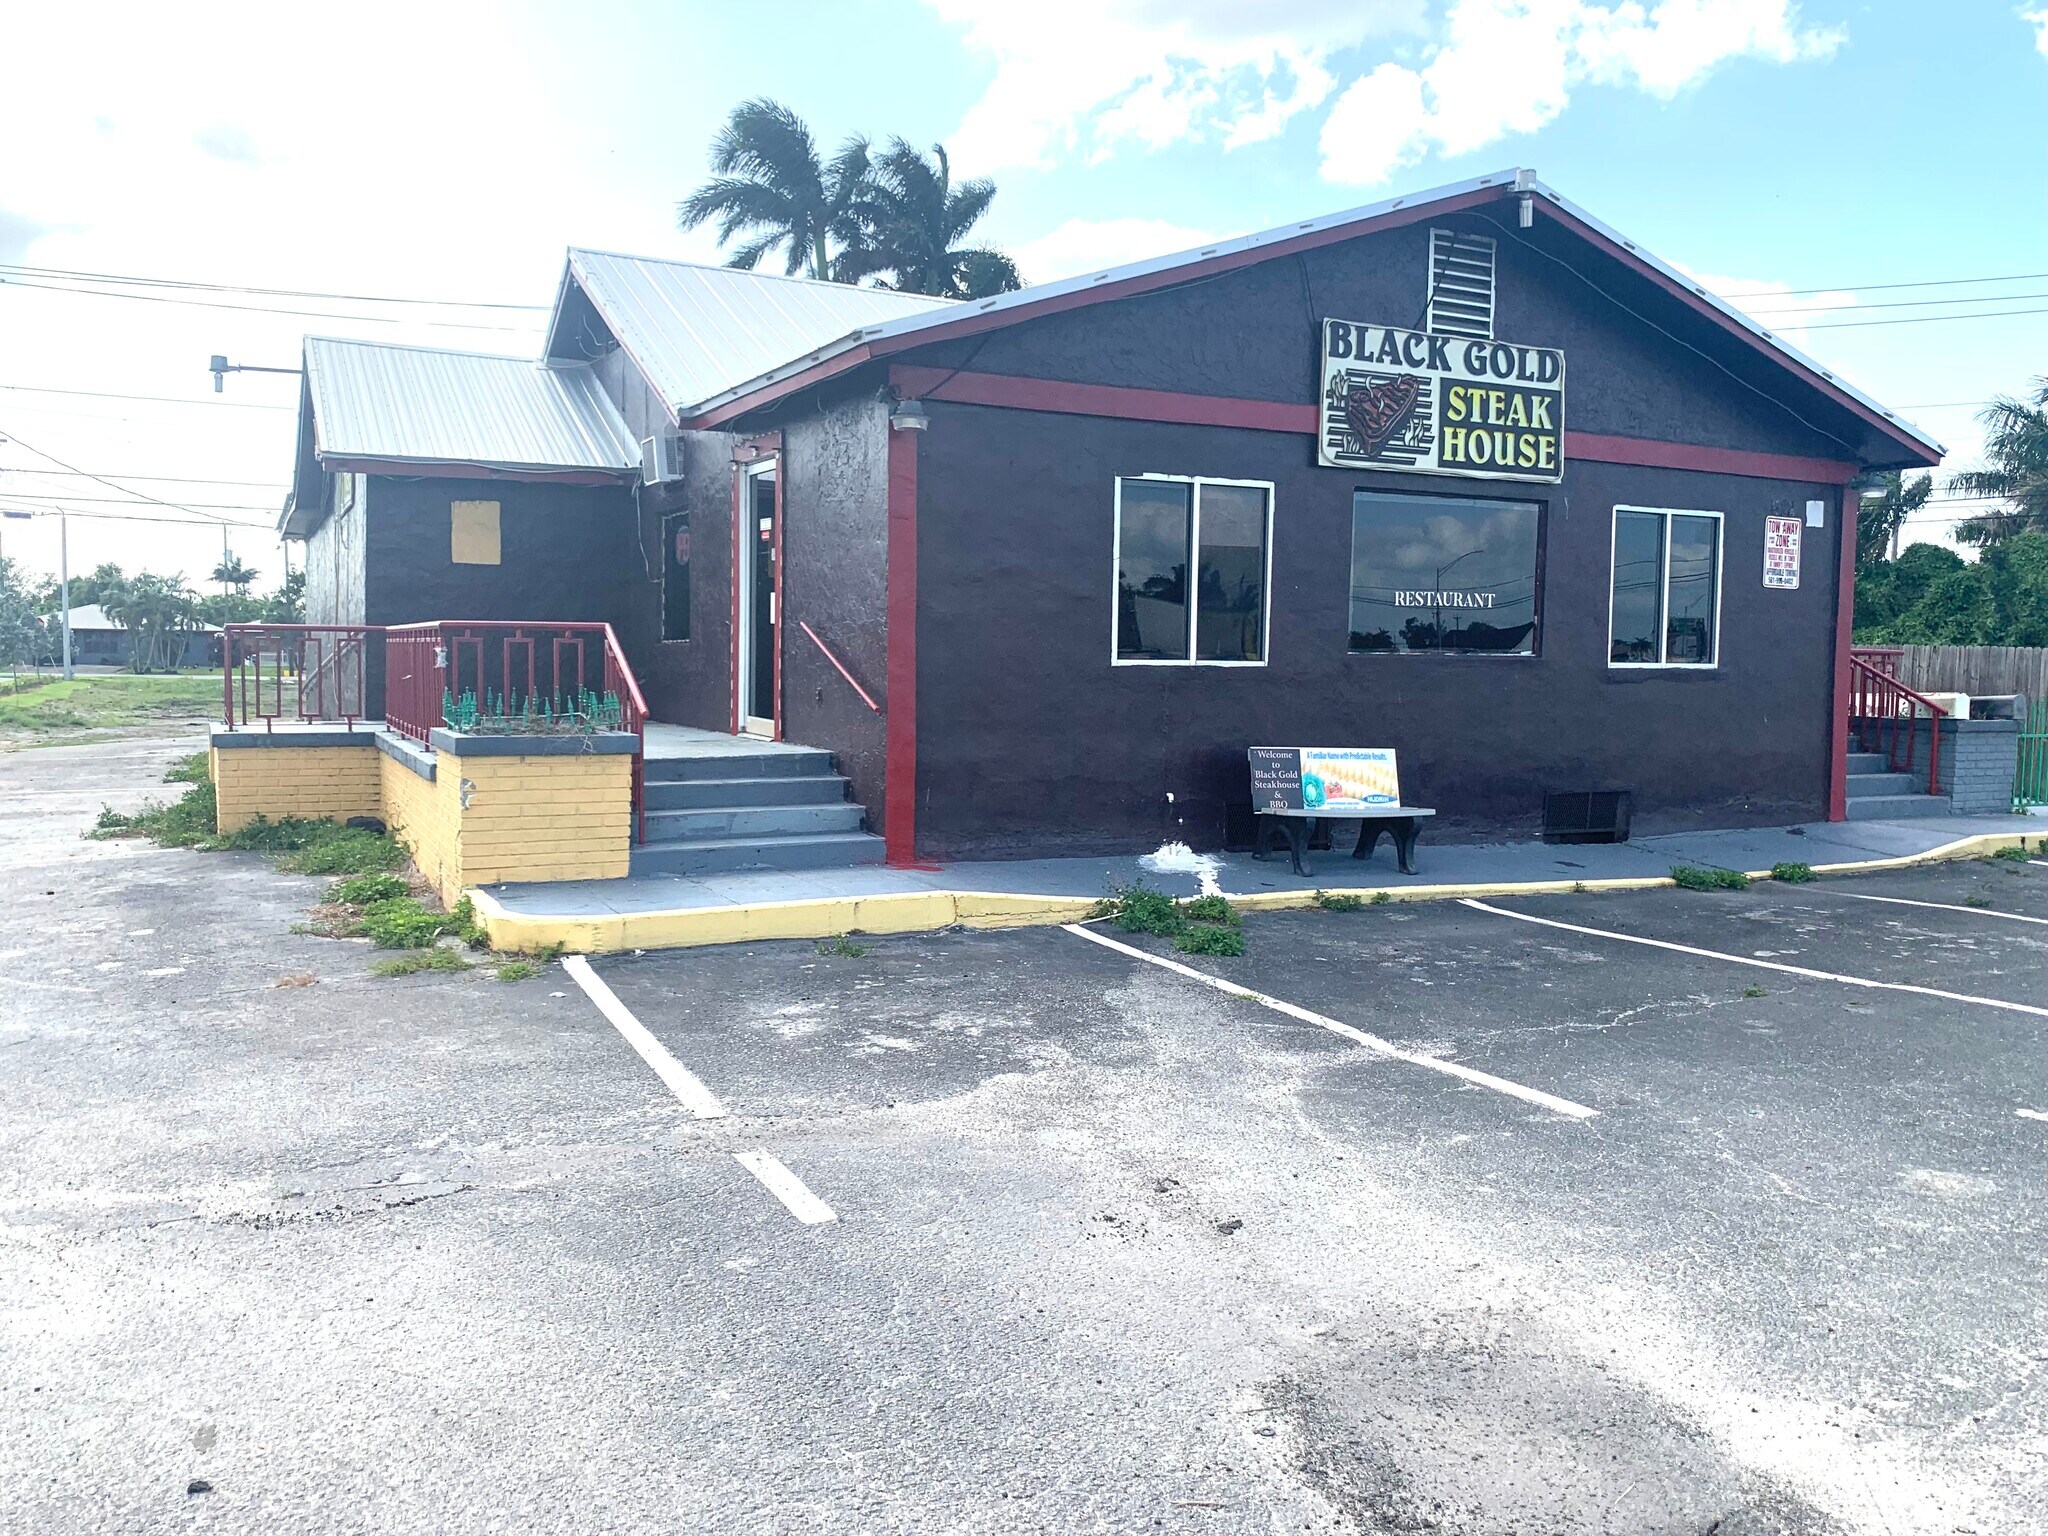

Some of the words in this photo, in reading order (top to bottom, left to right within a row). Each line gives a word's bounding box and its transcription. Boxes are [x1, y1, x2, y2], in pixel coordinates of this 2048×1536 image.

[1328, 322, 1452, 372] BLACK
[1463, 341, 1560, 384] GOLD
[1446, 385, 1554, 430] STEAK
[1442, 426, 1556, 470] HOUSE
[1769, 520, 1781, 534] TOW
[1782, 522, 1799, 535] AWAY
[1776, 534, 1790, 548] ZONE
[1394, 591, 1496, 608] RESTAURANT
[1257, 750, 1293, 759] Welcome
[1310, 751, 1326, 759] Familiar
[1327, 752, 1339, 760] Name
[1340, 751, 1348, 760] with
[1349, 752, 1371, 760] Predictable
[1255, 770, 1277, 778] Black
[1278, 770, 1298, 778] Gold
[1254, 780, 1300, 789] Steakhouse
[1274, 791, 1282, 799] &
[1269, 800, 1288, 808] BBQ
